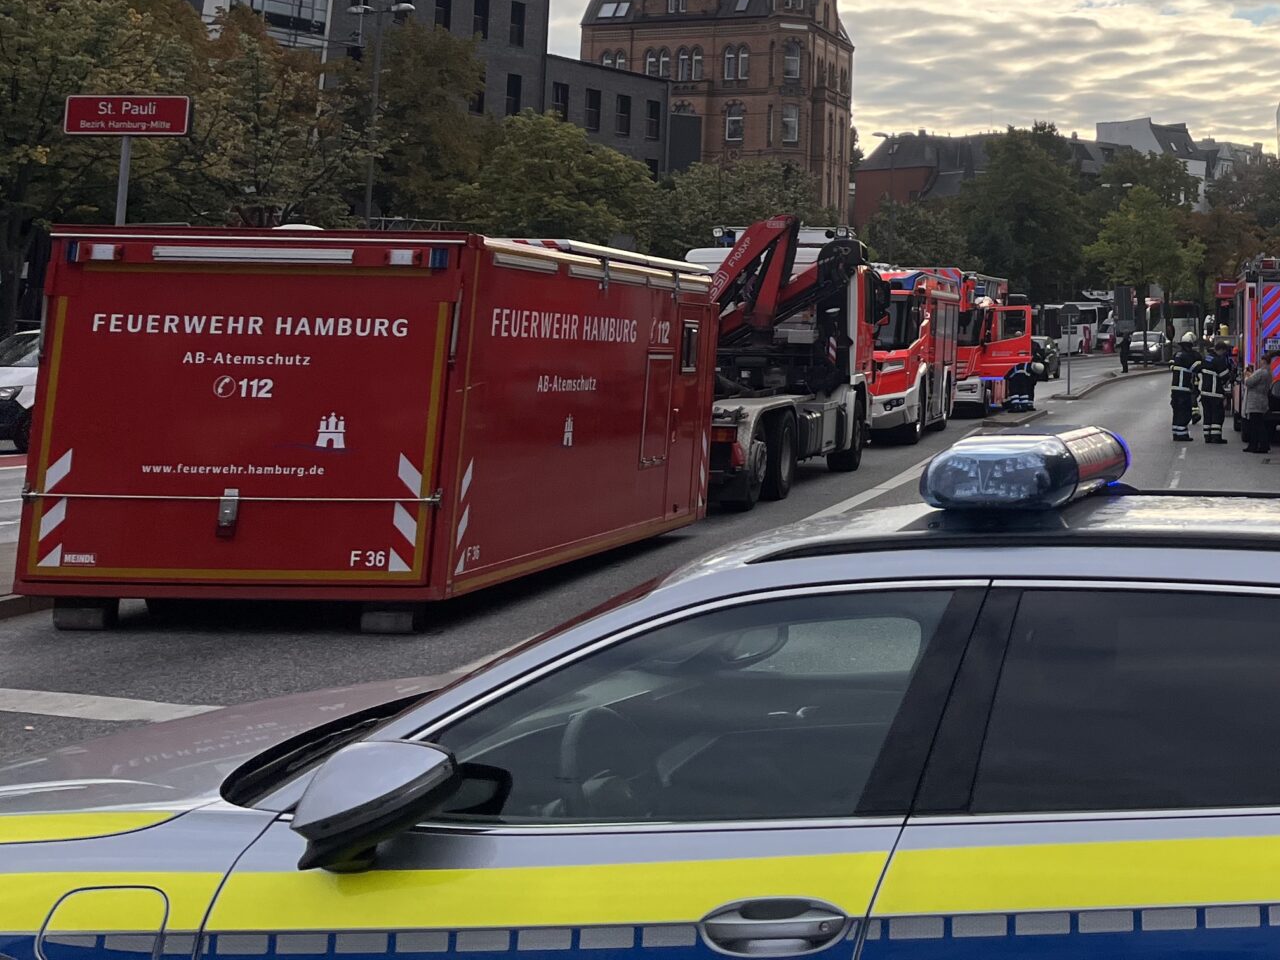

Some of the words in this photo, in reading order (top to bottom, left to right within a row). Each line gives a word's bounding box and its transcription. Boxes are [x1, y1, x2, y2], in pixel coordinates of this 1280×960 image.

[97, 101, 116, 115] St.
[121, 101, 157, 115] Pauli
[79, 119, 106, 129] Bezirk
[108, 120, 172, 130] Hamburg-Mitte
[92, 313, 264, 336] FEUERWEHR
[274, 316, 410, 337] HAMBURG
[491, 307, 579, 341] FEUERWEHR
[583, 315, 638, 344] HAMBURG
[657, 321, 671, 344] 112
[182, 351, 312, 366] AB-Atemschutz
[238, 378, 274, 398] 112
[537, 375, 597, 394] AB-Atemschutz
[141, 463, 325, 477] www.feuerwehr.hamburg.de
[64, 553, 96, 564] MEINDL
[350, 550, 362, 567] F
[365, 550, 386, 567] 36
